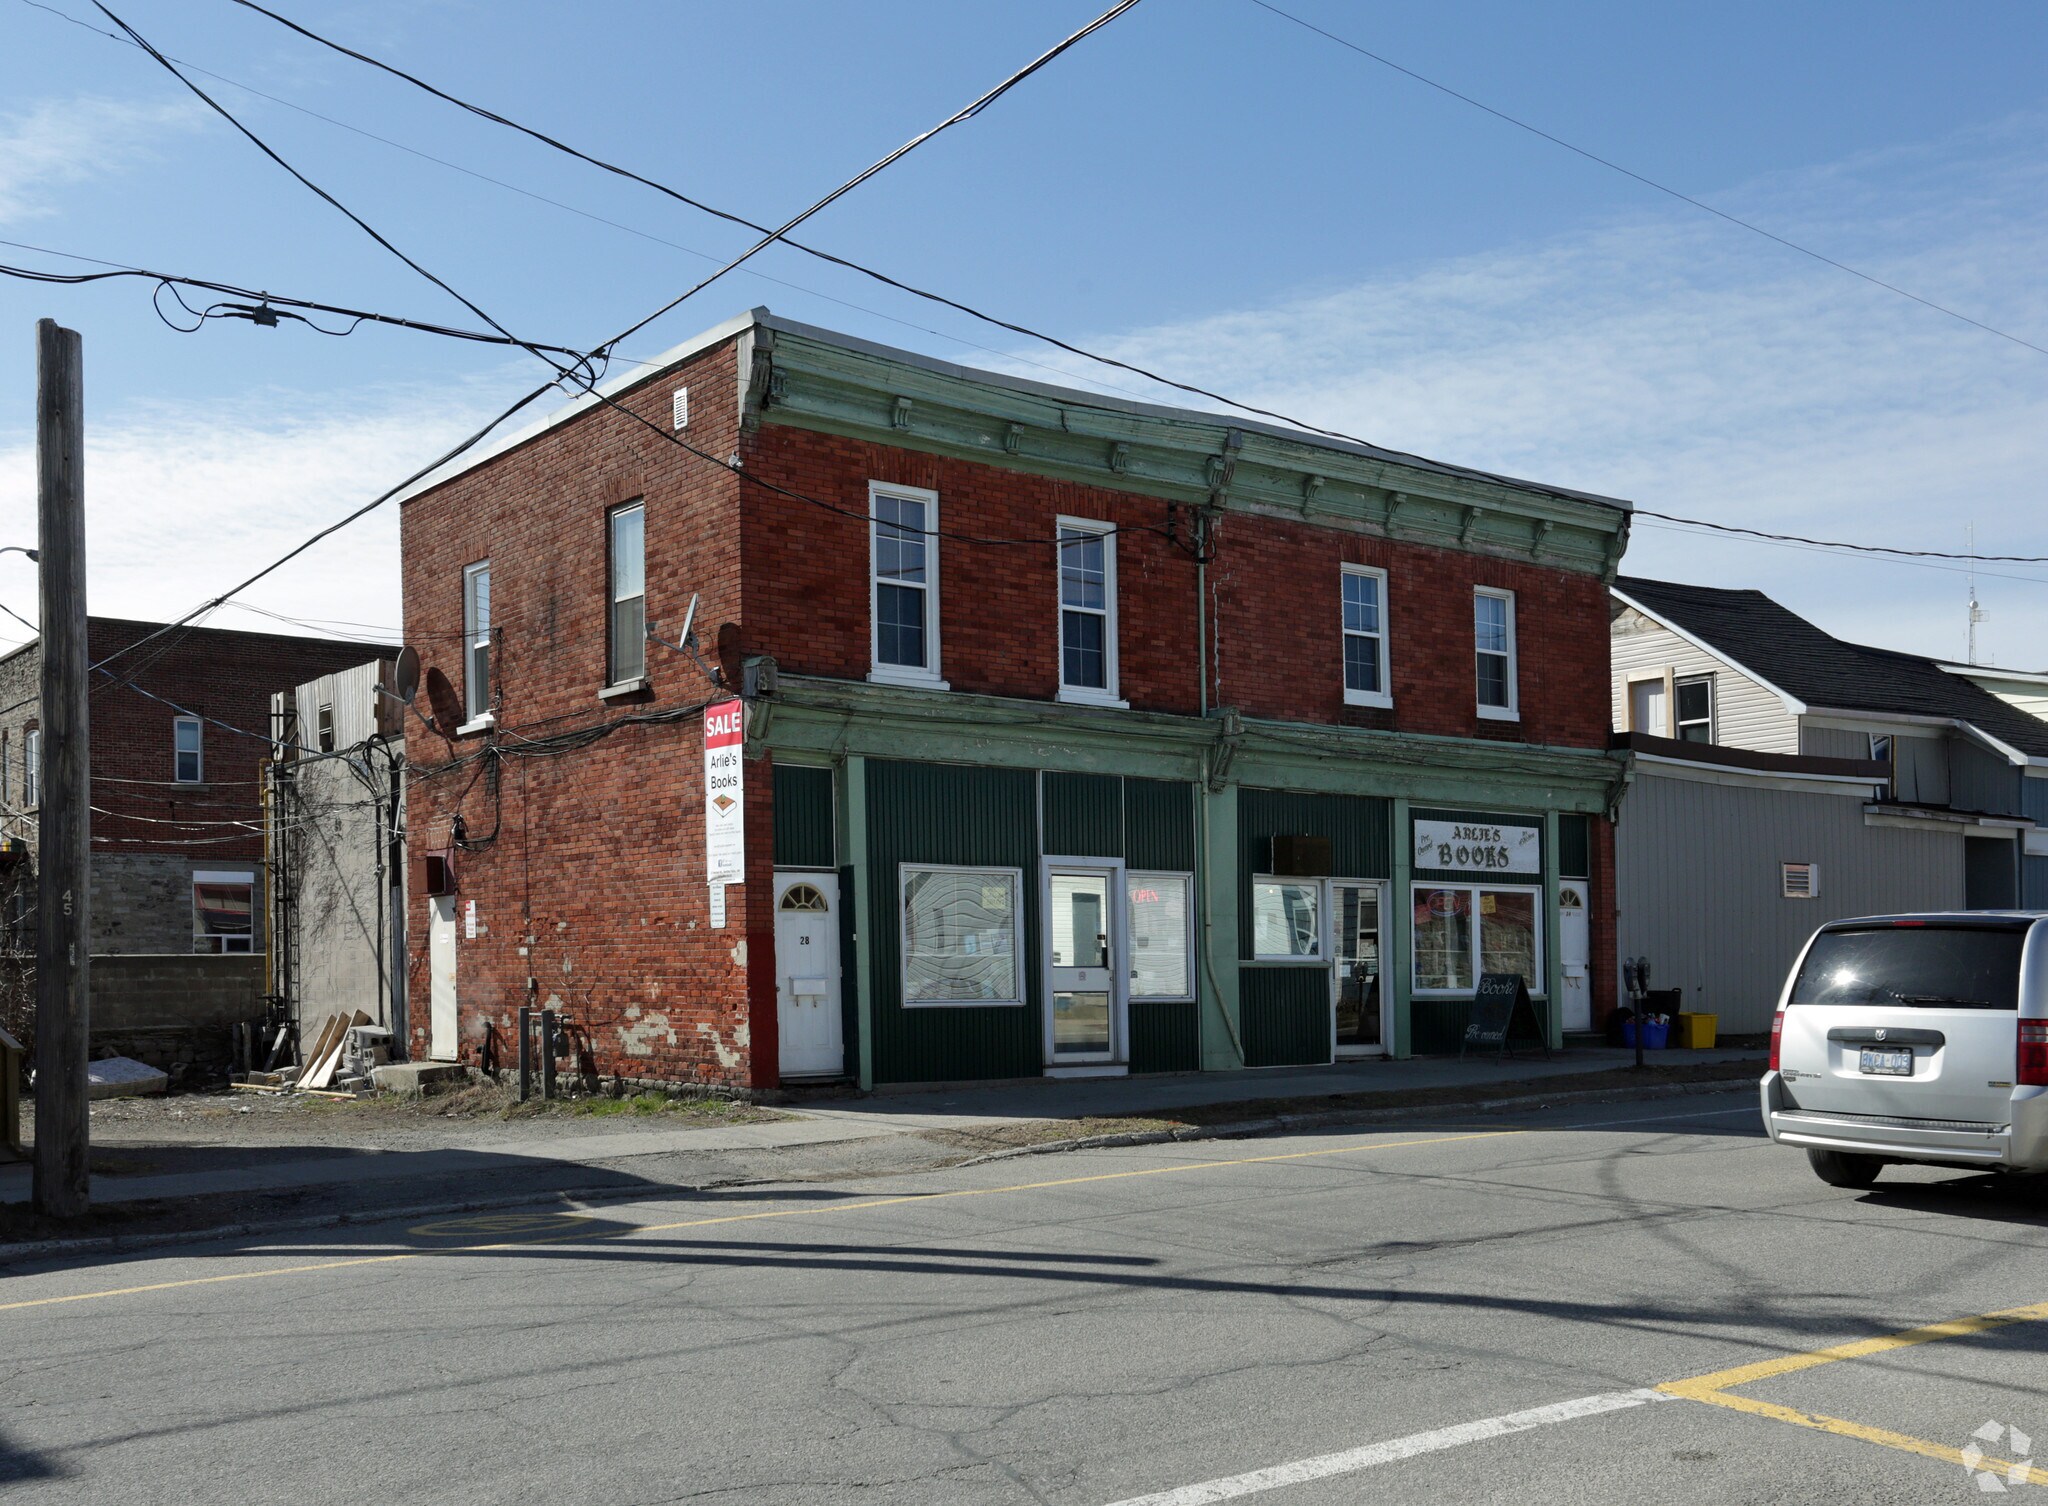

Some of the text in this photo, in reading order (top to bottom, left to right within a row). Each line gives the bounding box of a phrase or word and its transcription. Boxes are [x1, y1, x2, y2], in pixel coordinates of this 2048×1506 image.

[706, 712, 741, 737] SALE
[710, 752, 737, 769] Arlie's
[711, 774, 738, 790] Books
[1437, 842, 1509, 868] BOOKS
[1132, 889, 1159, 904] OPEN
[800, 936, 810, 945] 28
[1478, 977, 1515, 995] Books
